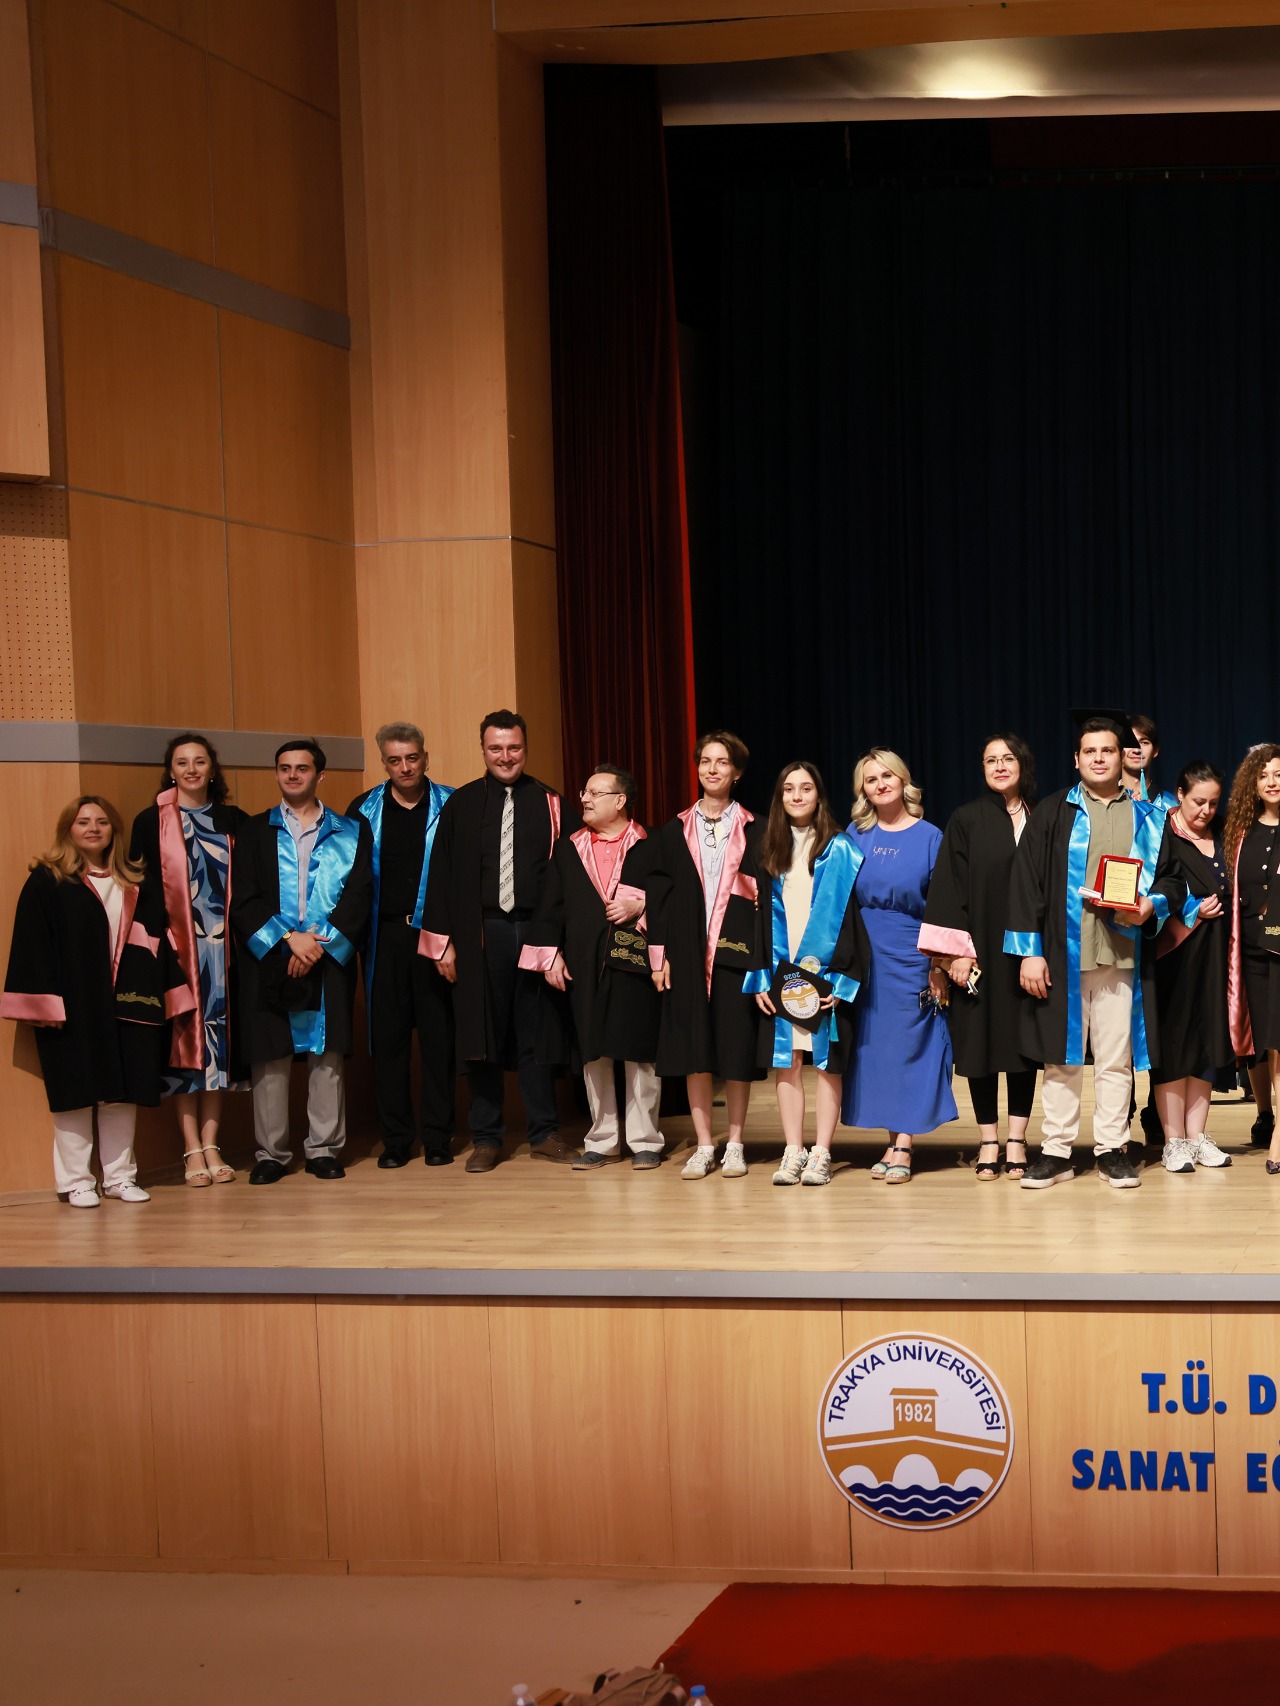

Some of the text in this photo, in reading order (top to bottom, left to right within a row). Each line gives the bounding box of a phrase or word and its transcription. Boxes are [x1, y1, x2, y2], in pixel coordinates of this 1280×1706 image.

[828, 1341, 1006, 1431] TRAKYA ÜNİVERSİTESİ
[1141, 1360, 1228, 1414] T.Ü.
[895, 1402, 933, 1423] 1982
[1072, 1448, 1215, 1492] SANAT
